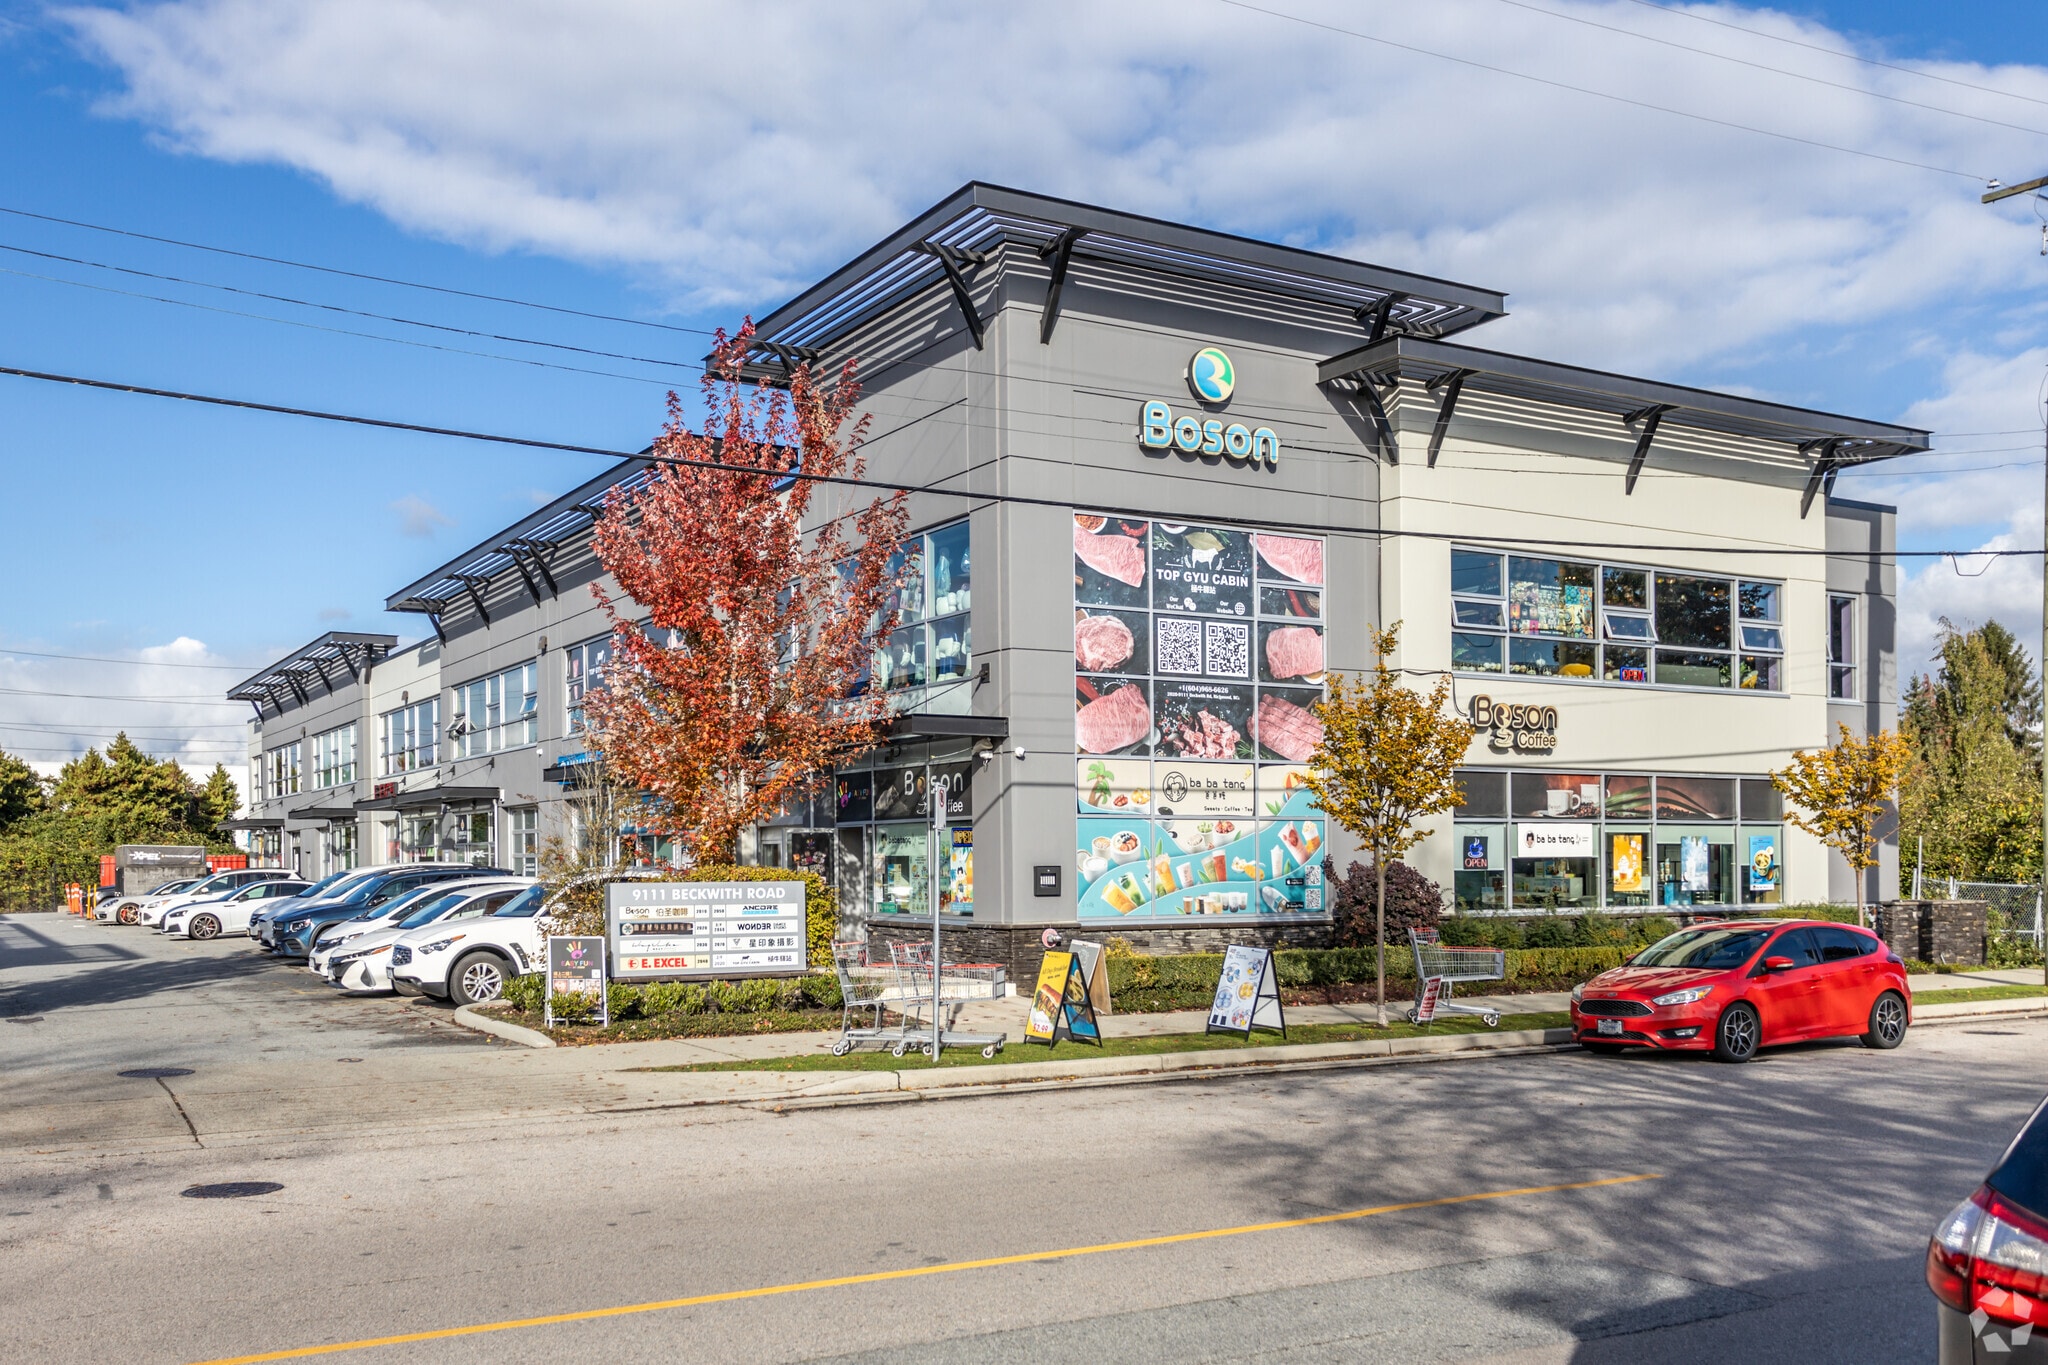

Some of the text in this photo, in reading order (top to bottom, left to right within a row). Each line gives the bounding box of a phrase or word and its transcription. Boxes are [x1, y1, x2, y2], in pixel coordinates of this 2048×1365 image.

[1142, 399, 1280, 464] Boson
[1156, 568, 1249, 587] TOP GYU CABIN
[1216, 607, 1234, 615] Website
[1622, 669, 1643, 681] OPEN
[1475, 694, 1559, 730] Boson
[1517, 730, 1557, 749] Coffee
[1189, 777, 1246, 790] ba ba tang
[1536, 834, 1545, 844] ba
[1547, 834, 1556, 844] ba
[1558, 834, 1575, 845] tang
[1464, 858, 1488, 868] OPEN
[632, 887, 786, 901] 9111 BECKWITH ROAD
[641, 957, 687, 968] E. EXCEL
